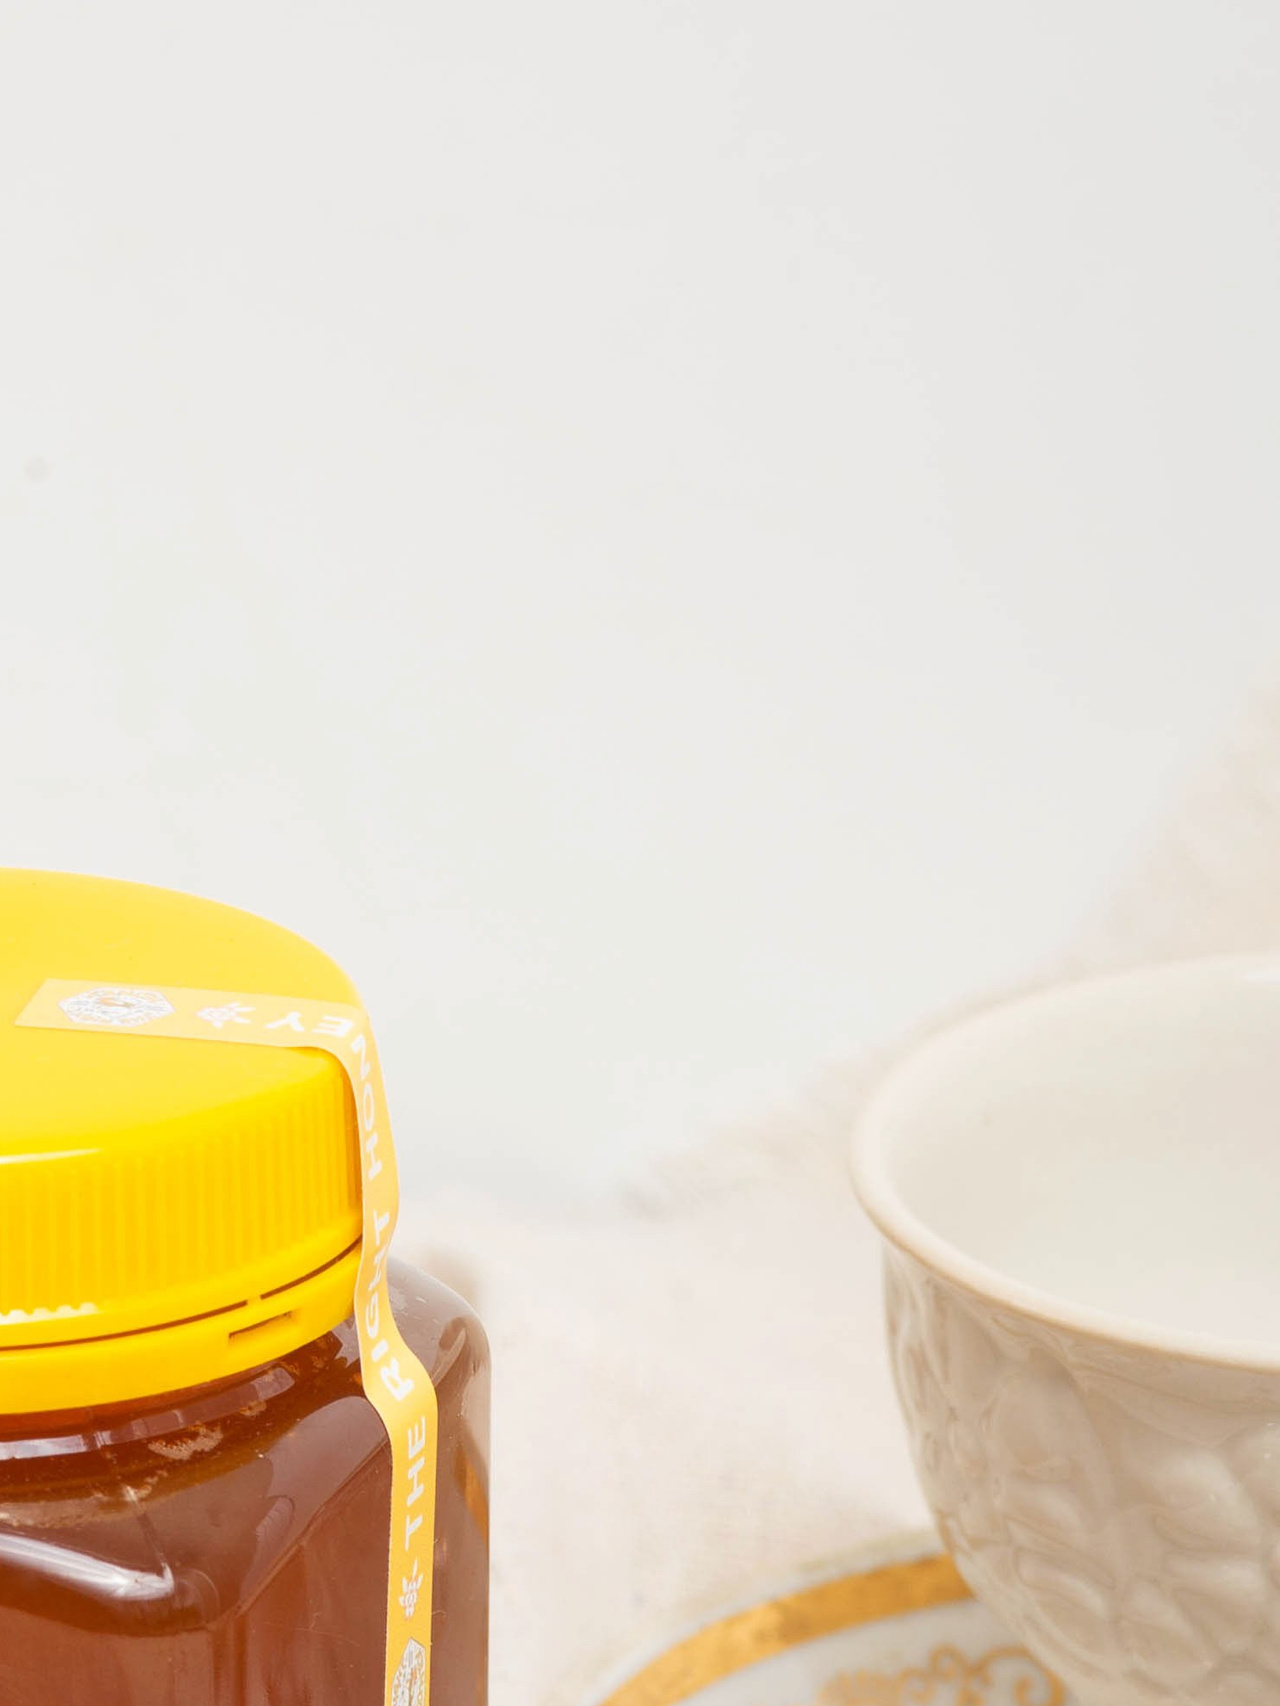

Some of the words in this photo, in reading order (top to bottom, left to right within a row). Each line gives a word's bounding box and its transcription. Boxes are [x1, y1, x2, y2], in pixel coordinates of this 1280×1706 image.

[263, 1010, 382, 1182] HONEY
[366, 1209, 415, 1402] RIGHT
[405, 1415, 426, 1552] THE
